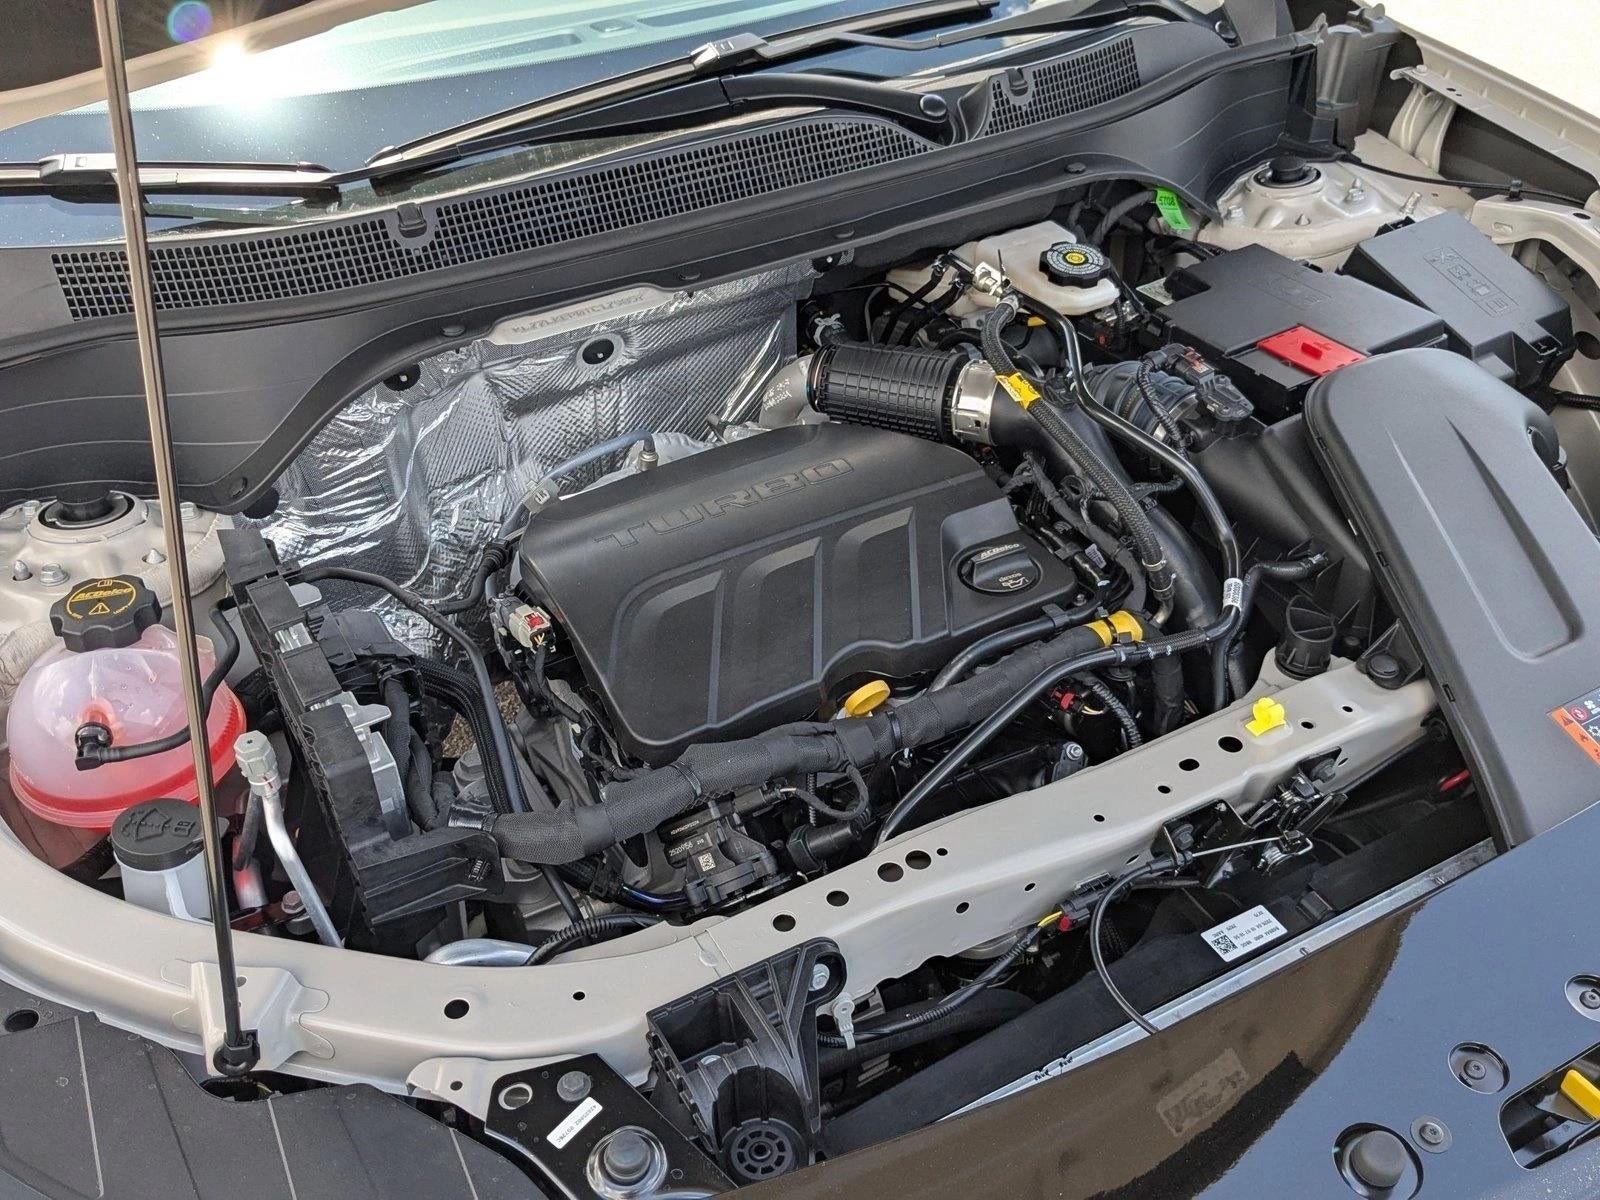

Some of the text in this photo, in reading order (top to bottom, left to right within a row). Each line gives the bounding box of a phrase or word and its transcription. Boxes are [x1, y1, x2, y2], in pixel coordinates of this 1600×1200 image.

[593, 456, 856, 550] TURBO
[981, 543, 1020, 559] ACDelco
[74, 586, 133, 601] ACDelco
